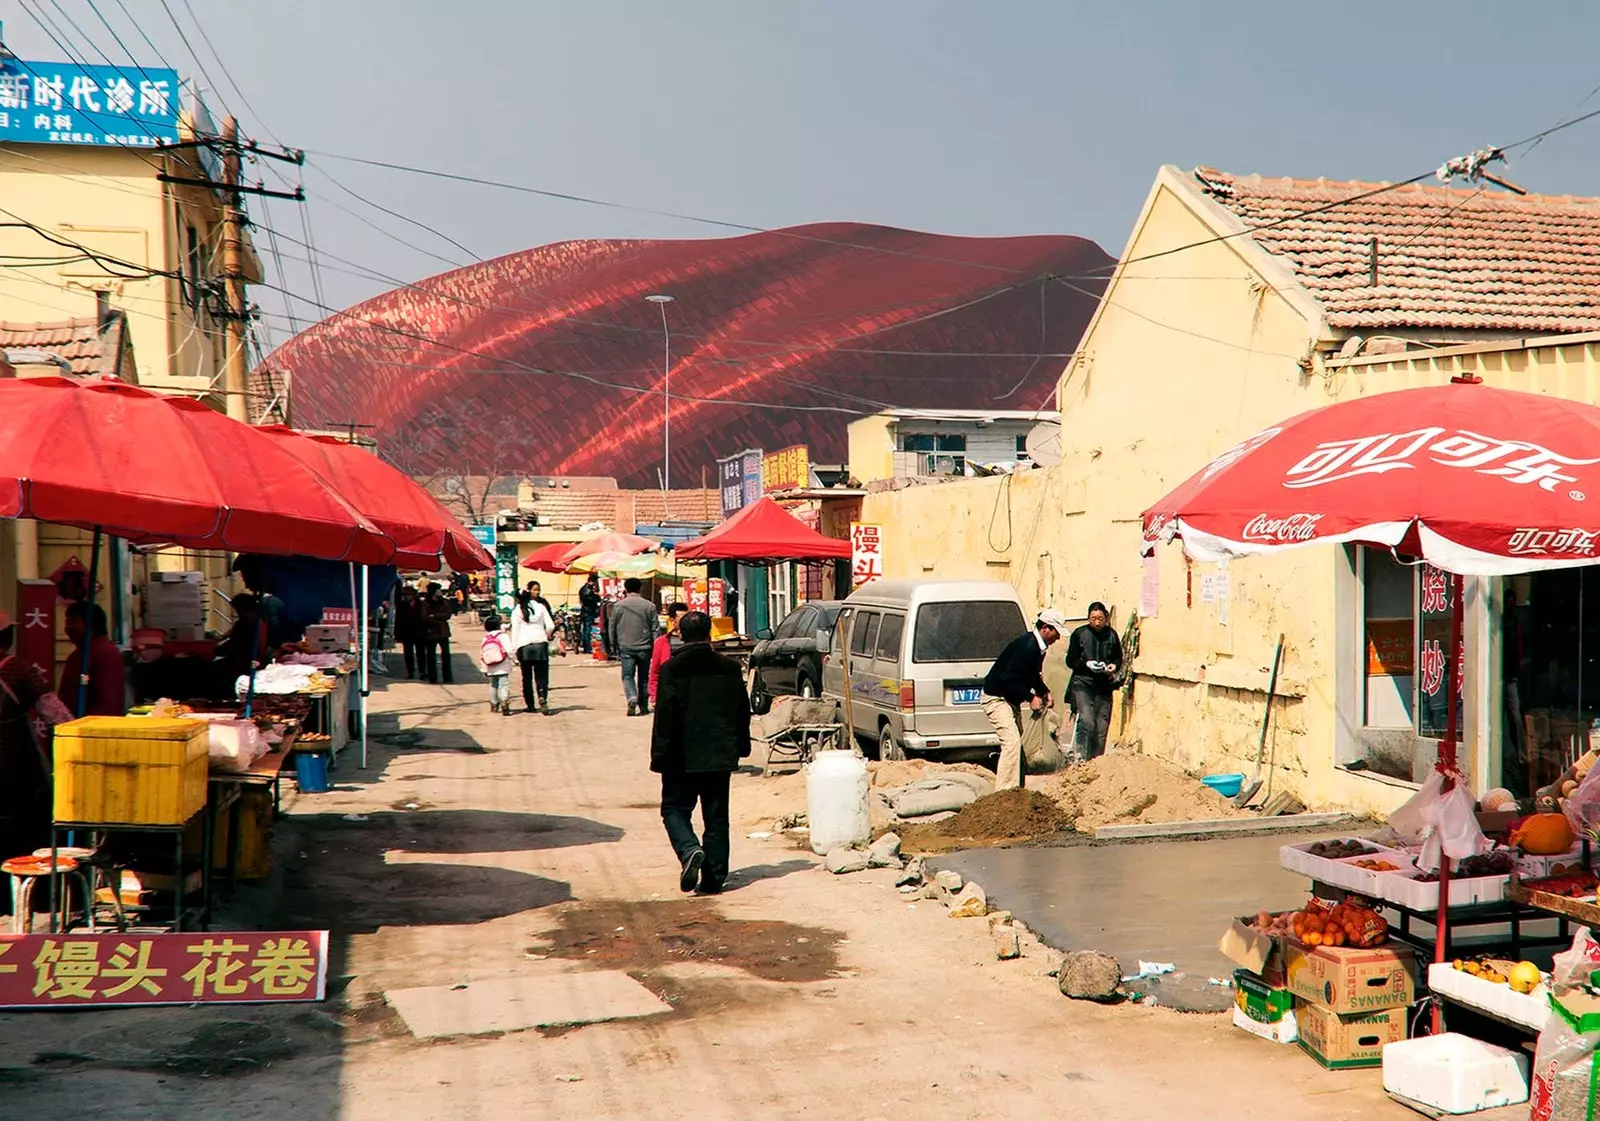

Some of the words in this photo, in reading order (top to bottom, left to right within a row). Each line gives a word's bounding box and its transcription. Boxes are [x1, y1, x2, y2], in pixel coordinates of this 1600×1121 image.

[0, 72, 170, 116] 新时代诊所
[1282, 426, 1600, 492] 可口可乐
[1243, 512, 1325, 542] Coca-Cola
[1507, 527, 1600, 555] 可口可乐
[852, 525, 882, 586] 馒头
[32, 938, 168, 999] 馒头
[181, 937, 316, 996] 花卷
[1350, 991, 1408, 1009] BANANAS
